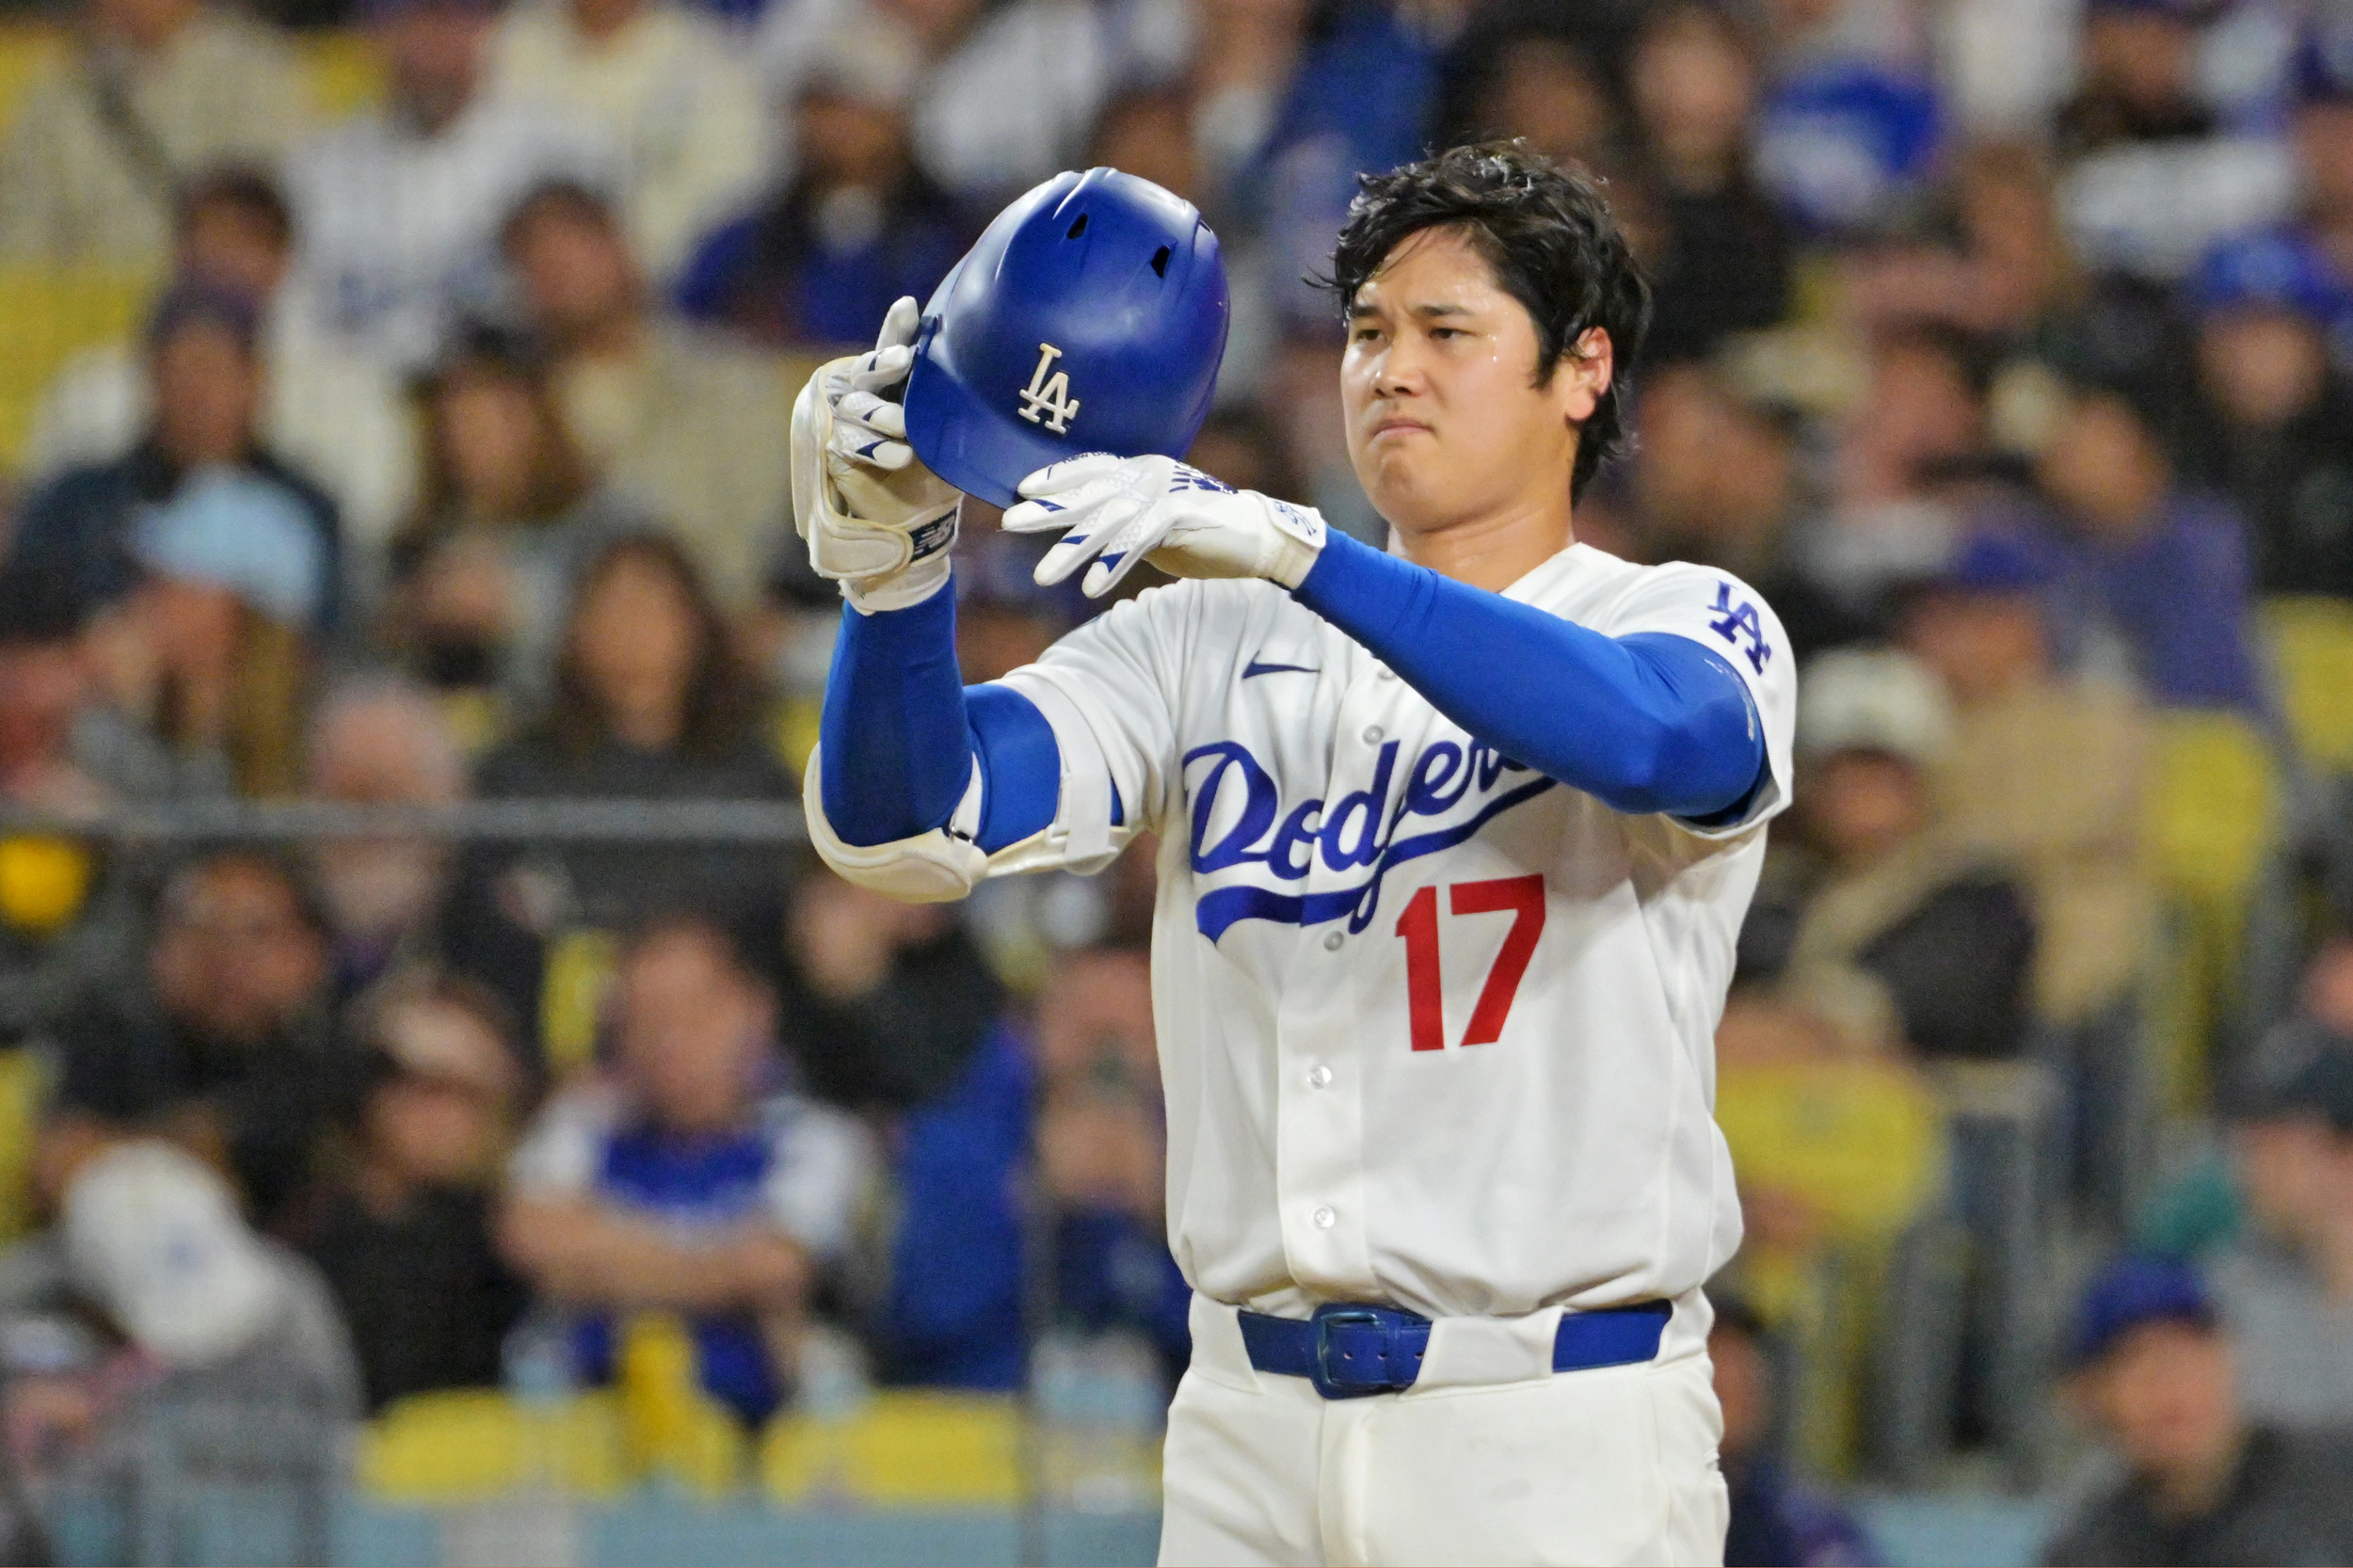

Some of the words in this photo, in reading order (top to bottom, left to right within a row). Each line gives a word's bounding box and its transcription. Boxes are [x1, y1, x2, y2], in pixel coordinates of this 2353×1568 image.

[1018, 343, 1080, 435] LA
[1707, 578, 1771, 676] LA
[1182, 740, 1531, 935] Doder
[1394, 873, 1546, 1052] 17
